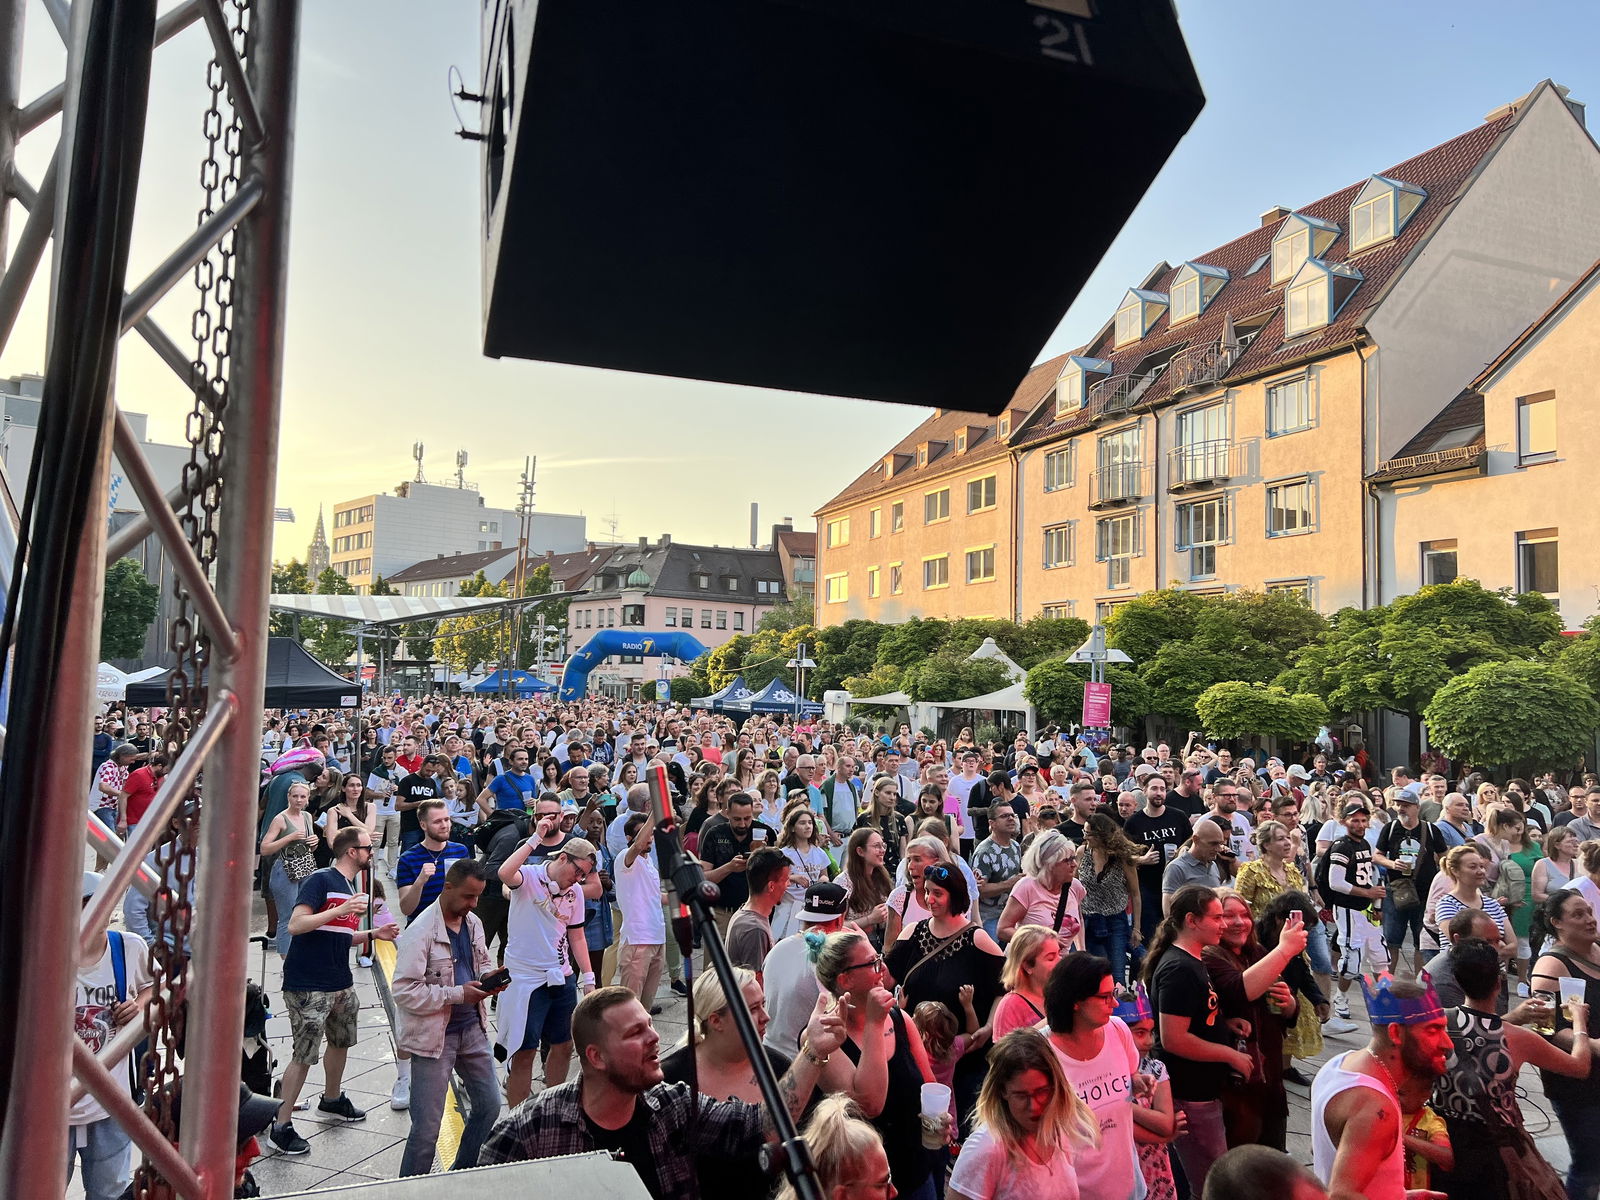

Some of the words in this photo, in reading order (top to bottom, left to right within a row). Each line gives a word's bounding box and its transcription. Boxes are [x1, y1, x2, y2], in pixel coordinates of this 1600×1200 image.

[622, 642, 643, 650] RADIO
[643, 640, 653, 653] 7
[411, 785, 434, 797] NASA
[1143, 827, 1177, 841] LXRY
[84, 984, 117, 1006] YOR
[1077, 1075, 1130, 1104] HOICE
